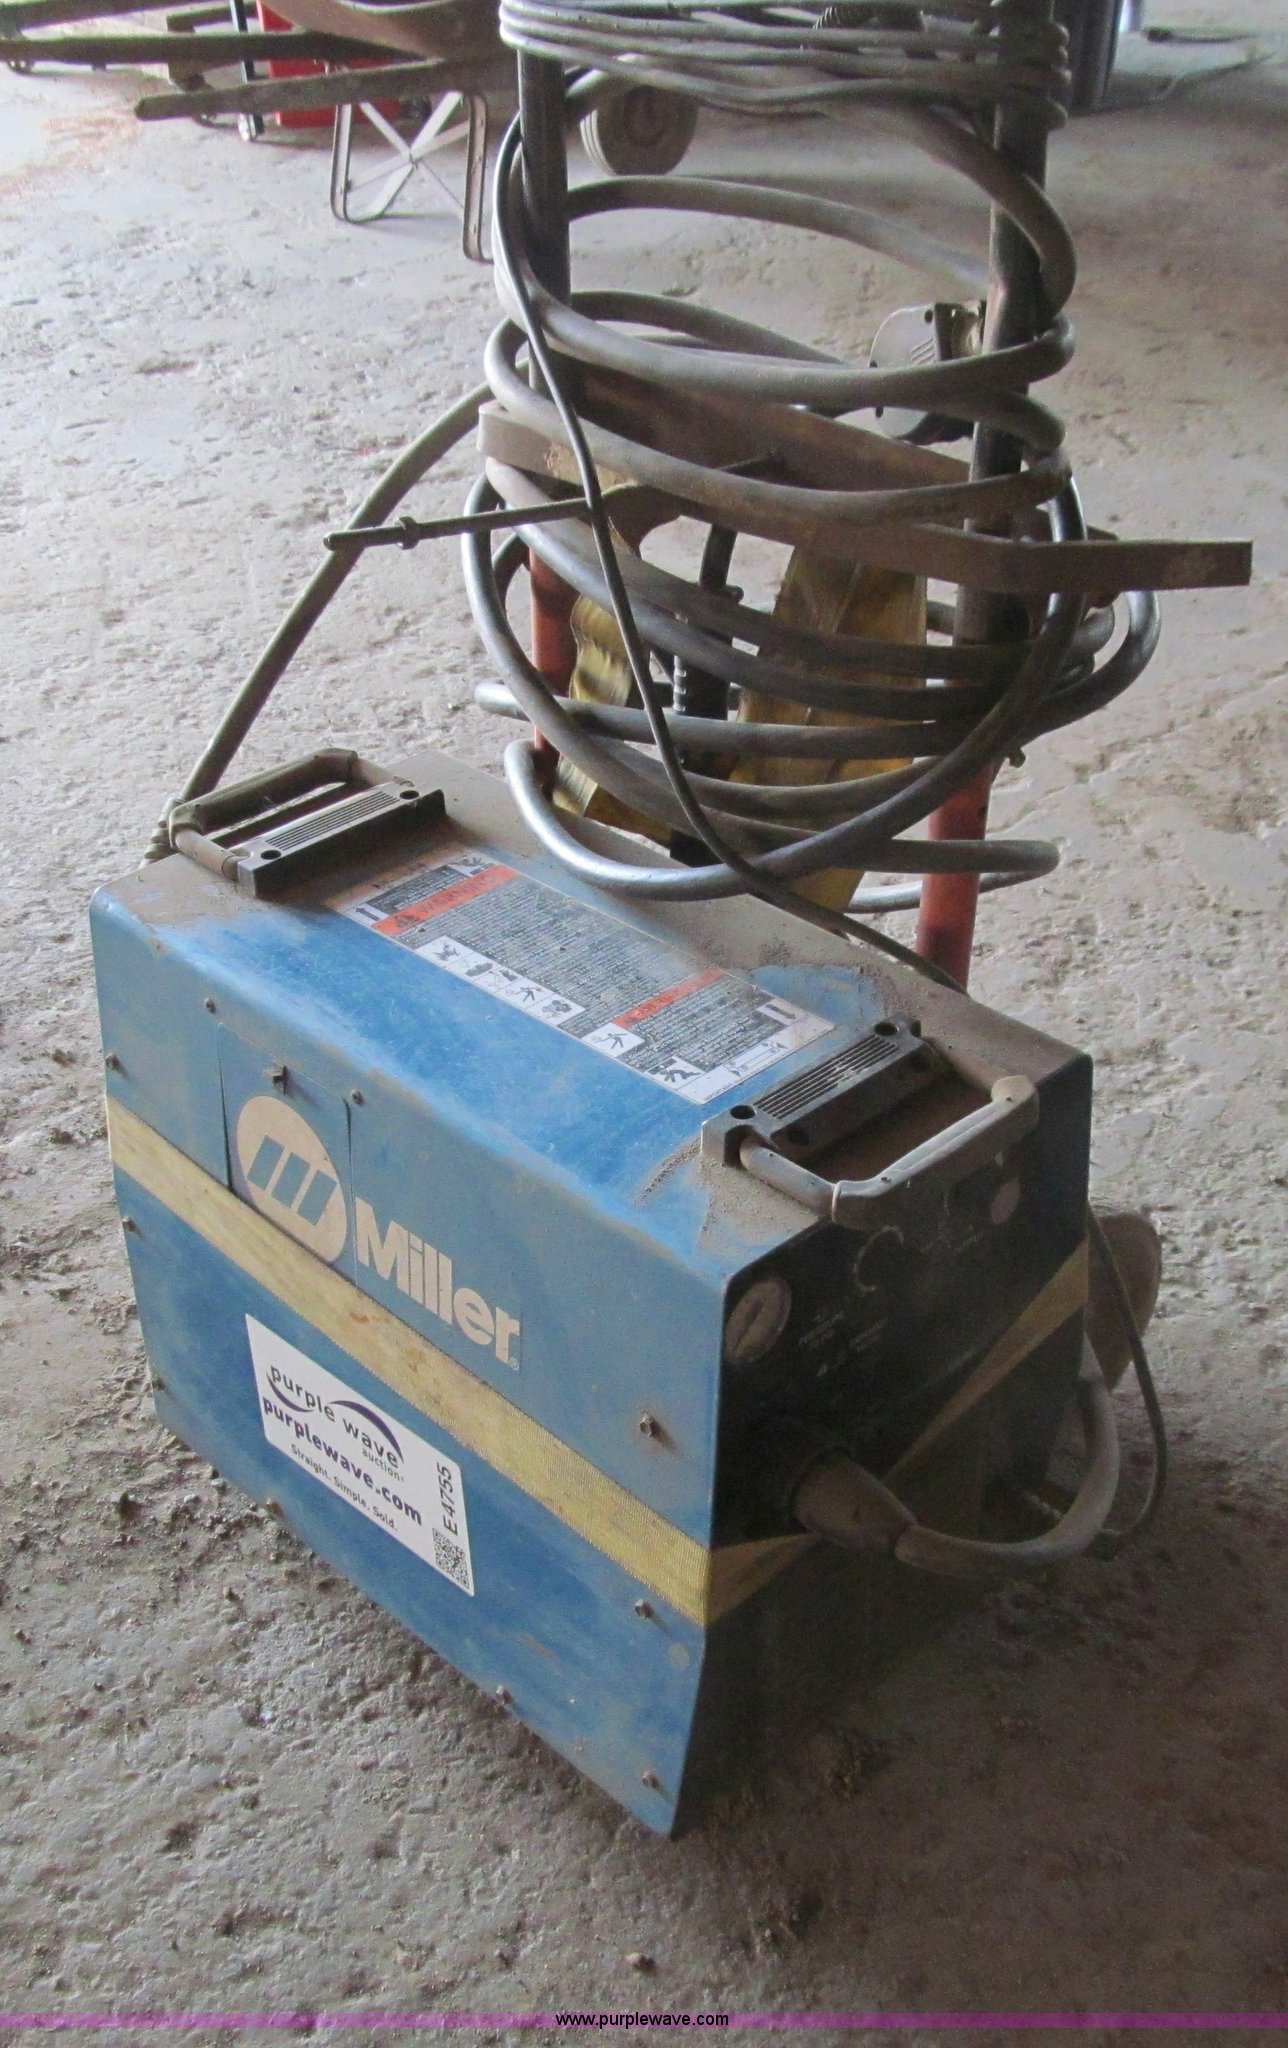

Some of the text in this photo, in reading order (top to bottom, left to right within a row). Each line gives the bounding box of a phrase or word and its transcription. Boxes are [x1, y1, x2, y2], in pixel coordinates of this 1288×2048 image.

[355, 1196, 521, 1363] Miller
[262, 1396, 422, 1526] purplewave.com
[270, 1365, 399, 1469] purple wave
[291, 1443, 398, 1532] Straight. Simple. Sold.
[436, 1461, 459, 1537] E4755
